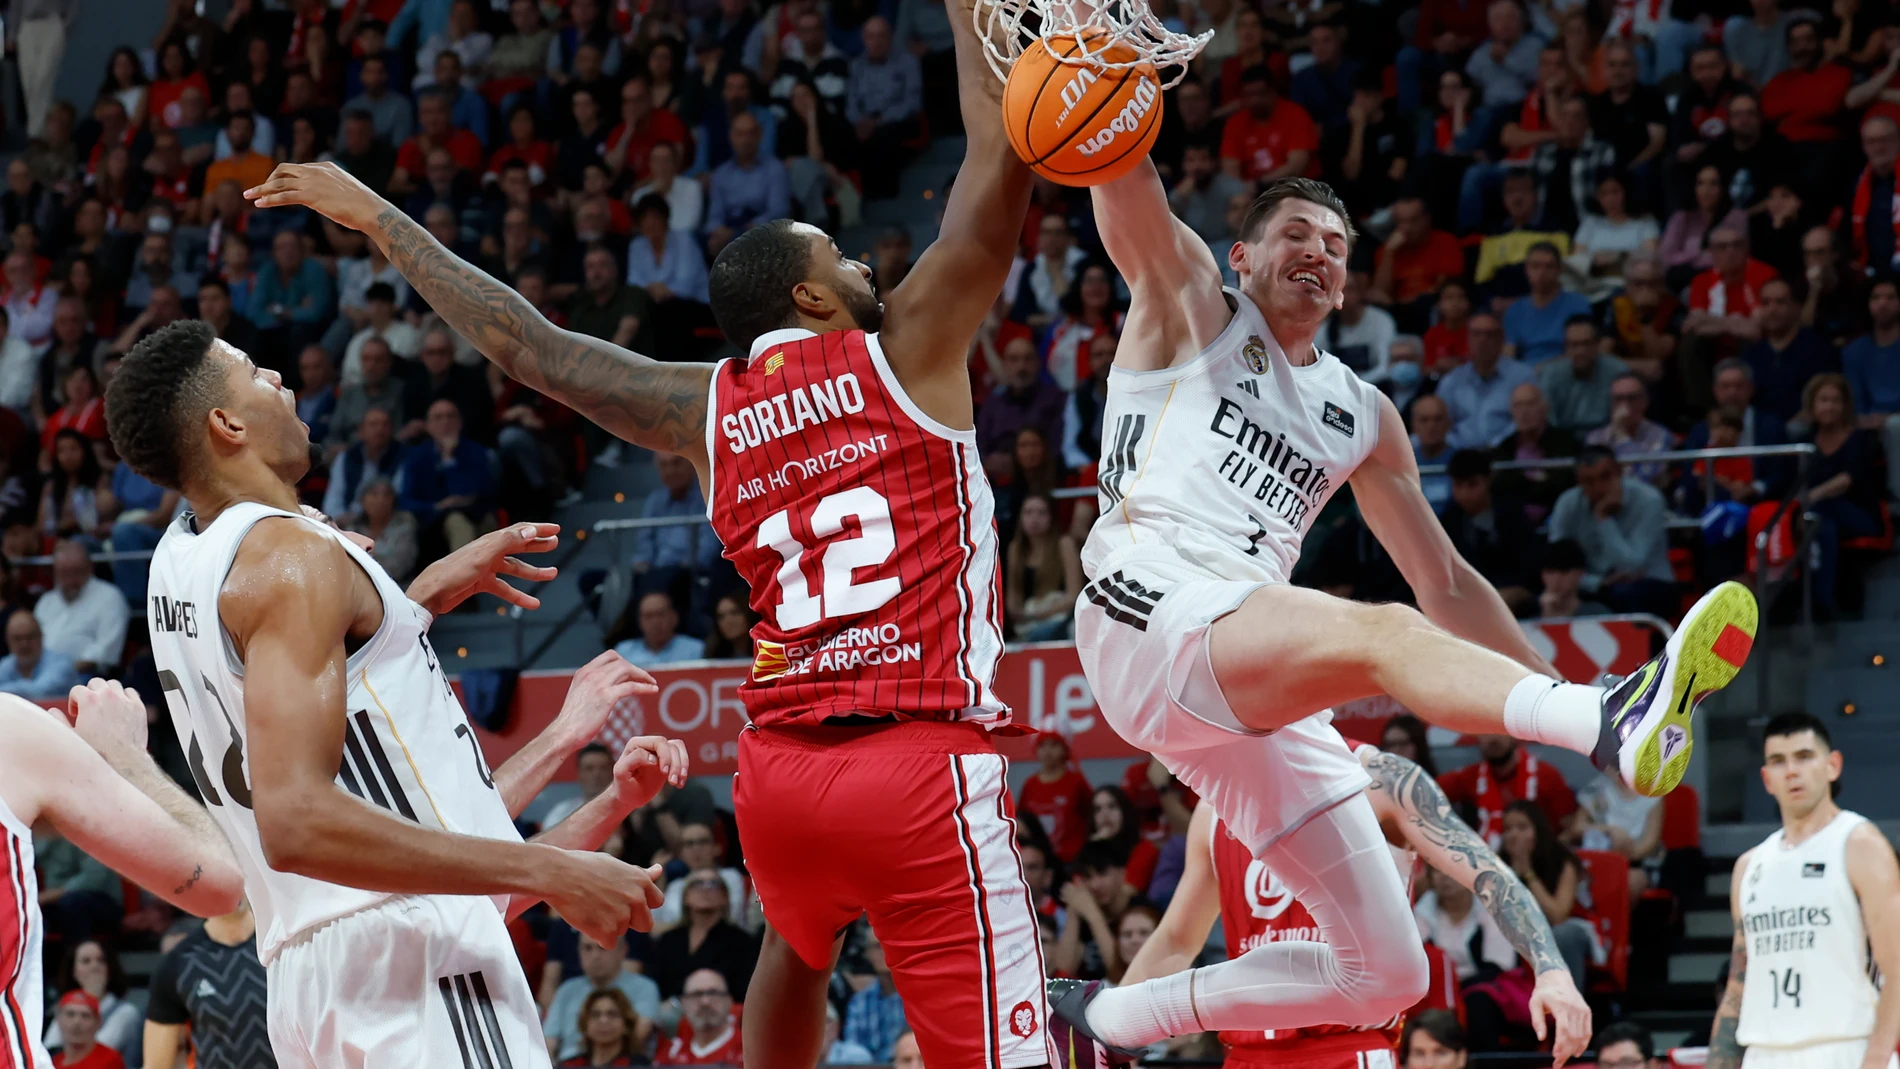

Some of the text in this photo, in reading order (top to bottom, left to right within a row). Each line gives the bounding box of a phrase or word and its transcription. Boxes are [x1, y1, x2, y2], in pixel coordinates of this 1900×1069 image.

[1076, 75, 1157, 158] Wilson
[721, 373, 866, 455] SORIANO
[1210, 396, 1330, 508] Emirates
[737, 434, 889, 504] AIR HORIZONT
[1218, 450, 1309, 533] FLY BETTER
[756, 485, 902, 632] 12
[785, 642, 921, 676] DE ARAGON
[1769, 967, 1802, 1009] 14
